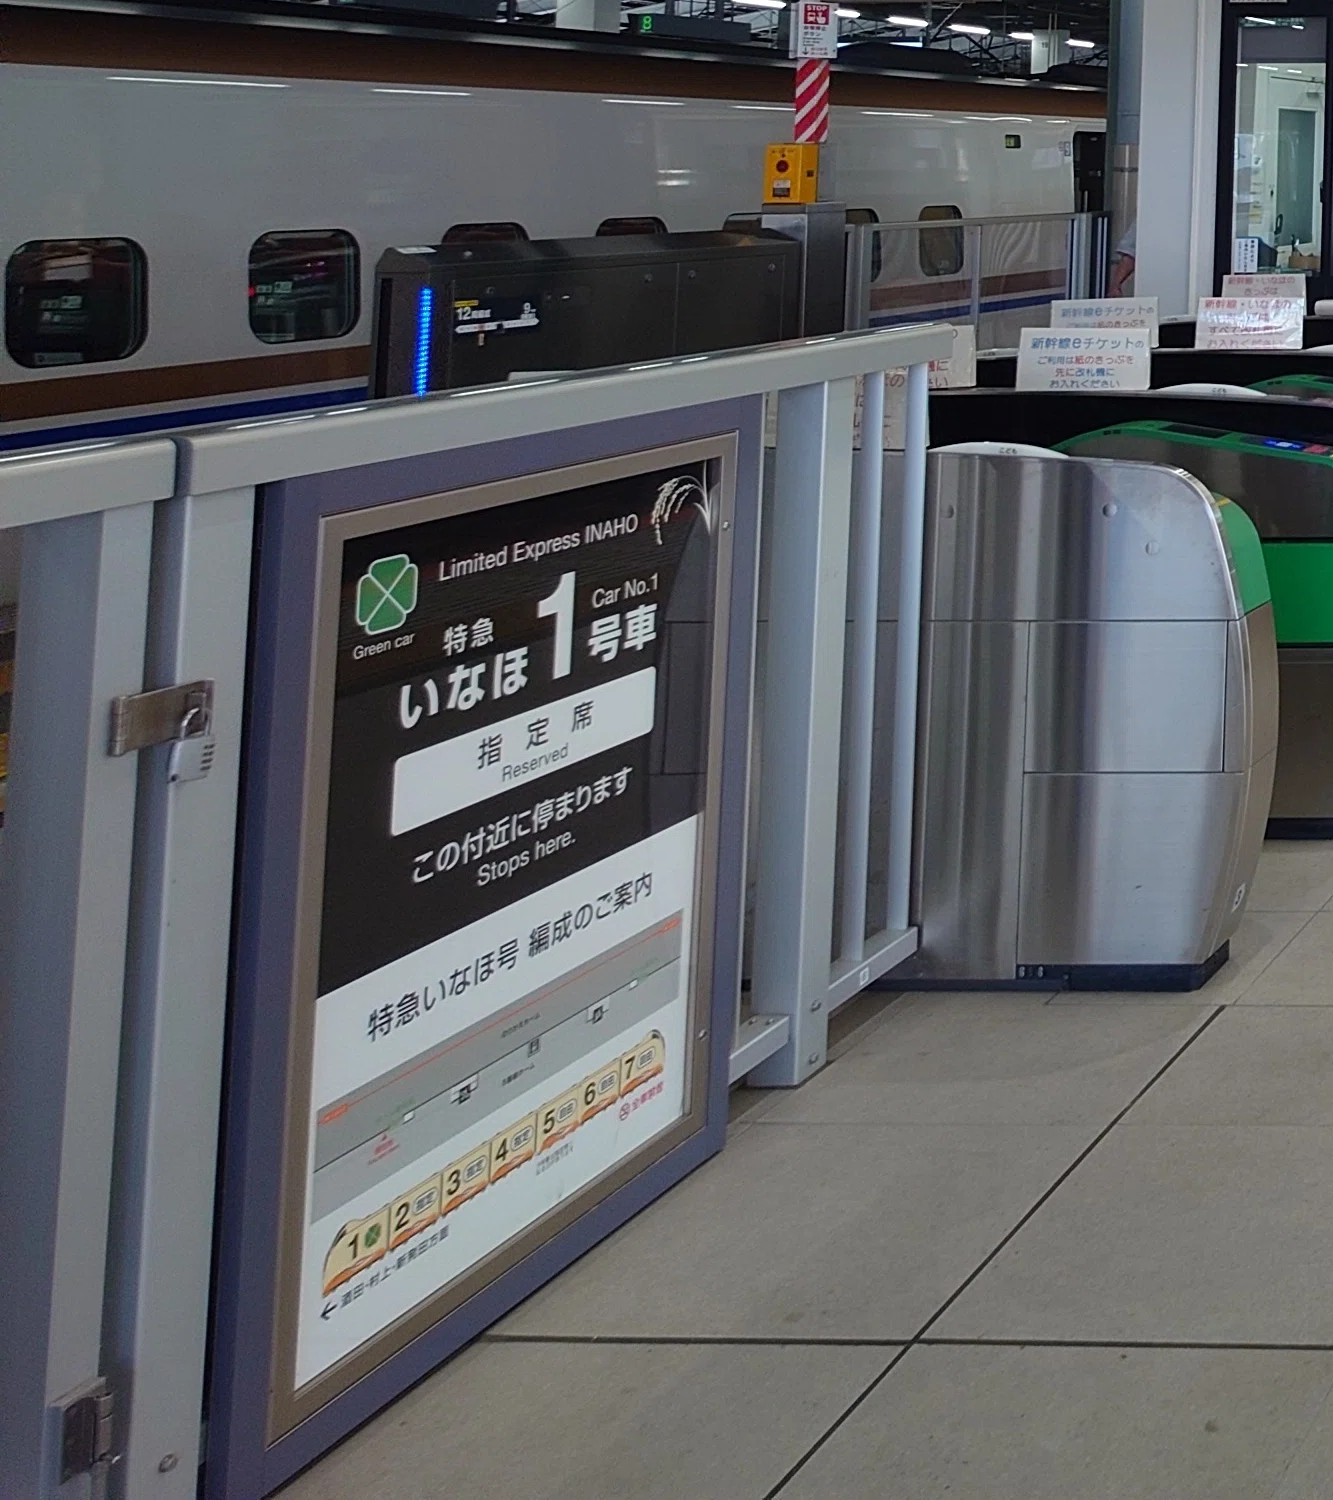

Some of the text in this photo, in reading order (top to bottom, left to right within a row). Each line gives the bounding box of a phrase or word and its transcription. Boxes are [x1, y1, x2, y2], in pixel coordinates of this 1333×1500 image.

[641, 15, 652, 30] 8
[1061, 305, 1155, 317] 新幹線eチケットの
[1030, 337, 1145, 350] 新幹線eチケットの
[1037, 355, 1134, 365] ご利用は紙のきっぷを
[1055, 367, 1115, 377] 先に改札機に
[1049, 379, 1120, 389] お入れください
[438, 513, 639, 583] Limited Express INAHO
[591, 573, 660, 610] Car No.1
[353, 632, 416, 661] Green car
[399, 571, 658, 730] いなほ 1 号車
[443, 617, 495, 658] 特急
[477, 700, 594, 770] 指定席
[502, 743, 570, 782] Reserved
[411, 765, 634, 884] この付近に停まります
[476, 831, 577, 887] Stops here.
[367, 871, 655, 1043] 特急いなほ号 編成のご案内
[625, 1056, 636, 1080] 7
[584, 1081, 596, 1106] 6
[543, 1109, 555, 1134] 5
[495, 1138, 509, 1162] 4
[447, 1169, 461, 1195] 3
[394, 1202, 410, 1232] 2
[347, 1233, 359, 1260] 1
